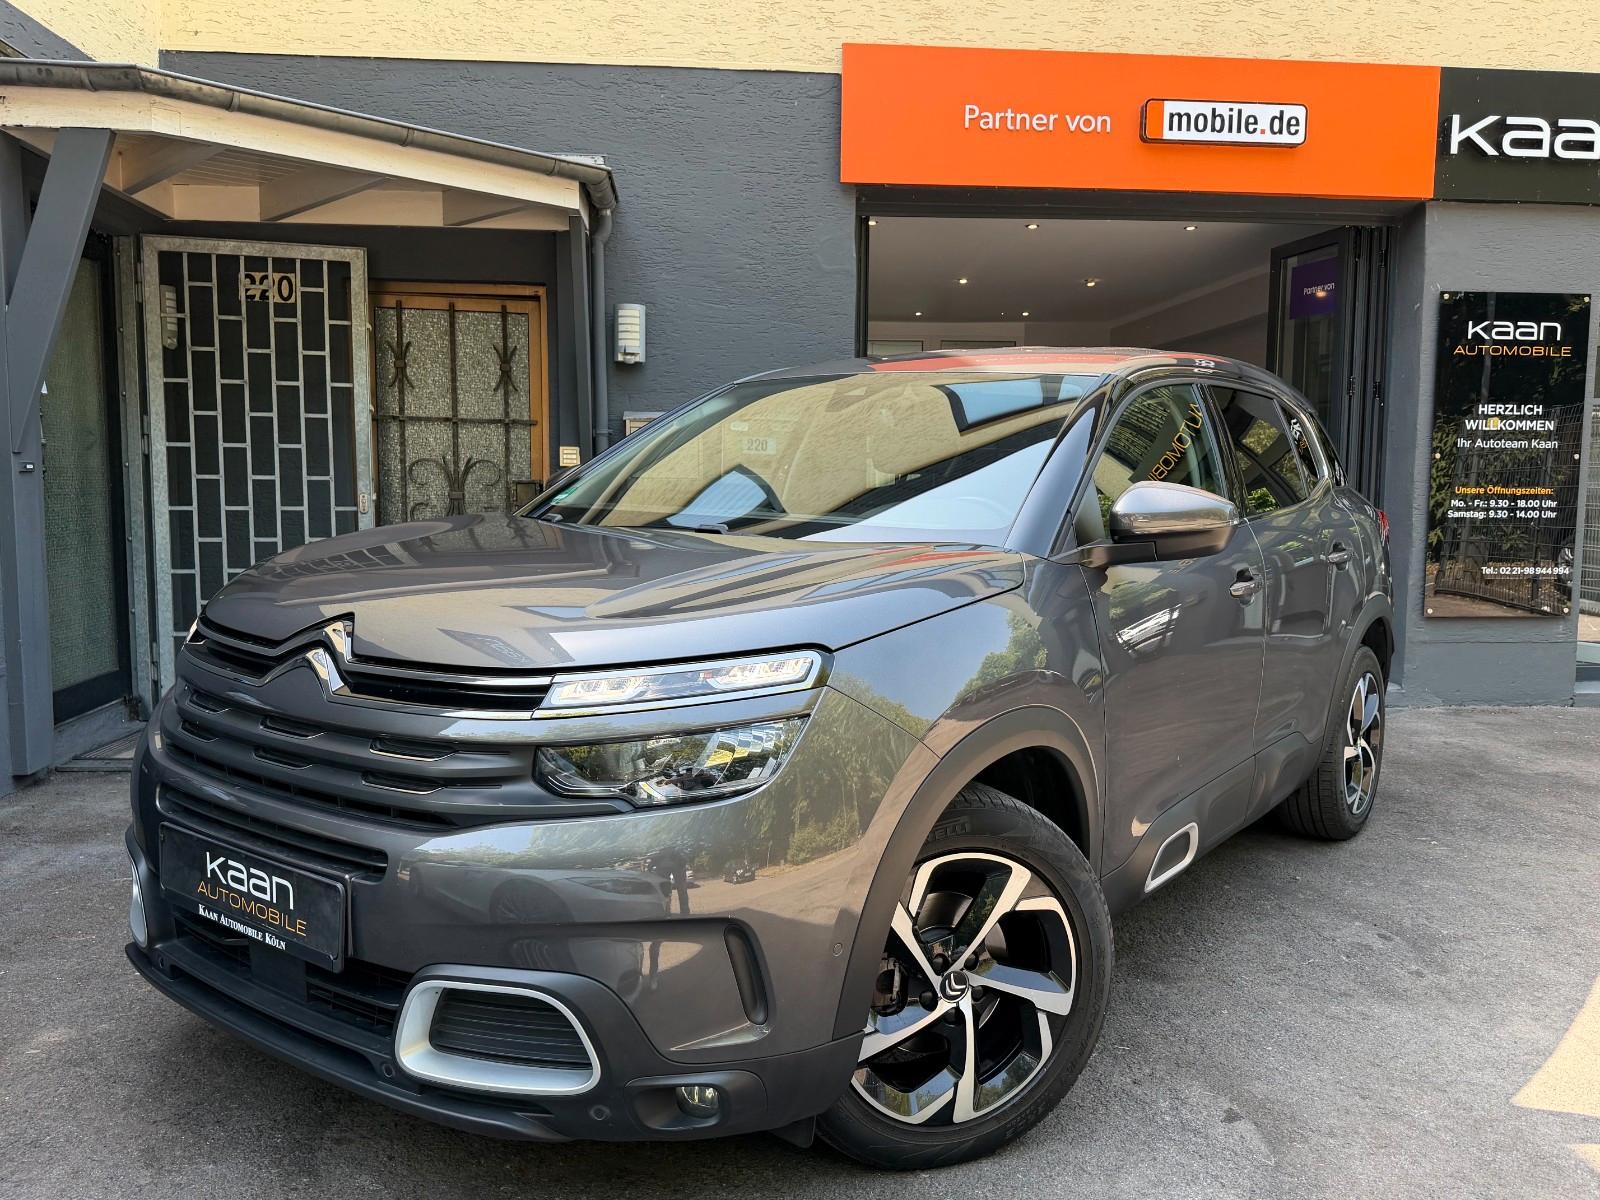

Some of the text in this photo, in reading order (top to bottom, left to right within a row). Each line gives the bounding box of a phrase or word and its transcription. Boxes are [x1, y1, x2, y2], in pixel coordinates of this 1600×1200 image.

[964, 104, 1112, 133] Partner von
[1168, 106, 1301, 136] mobile.de
[1324, 282, 1335, 291] von
[1453, 345, 1572, 357] AUTOMOBILE
[1478, 403, 1543, 415] HERZLICH
[1464, 419, 1554, 431] WILLKOMMEN
[1457, 437, 1558, 449] Ihr Autoteam Kaan
[1455, 485, 1554, 496] Unsere Öffnungszeiten:
[1450, 499, 1466, 508] Mo.
[1489, 499, 1509, 508] 9.30
[1517, 499, 1540, 508] 18.00
[1541, 499, 1558, 508] Uhr
[1447, 510, 1487, 519] Samstag:
[1488, 510, 1508, 518] 9.30
[1516, 510, 1540, 518] 14.00
[1541, 510, 1558, 518] Uhr
[197, 880, 307, 937] AUTOMOBILE
